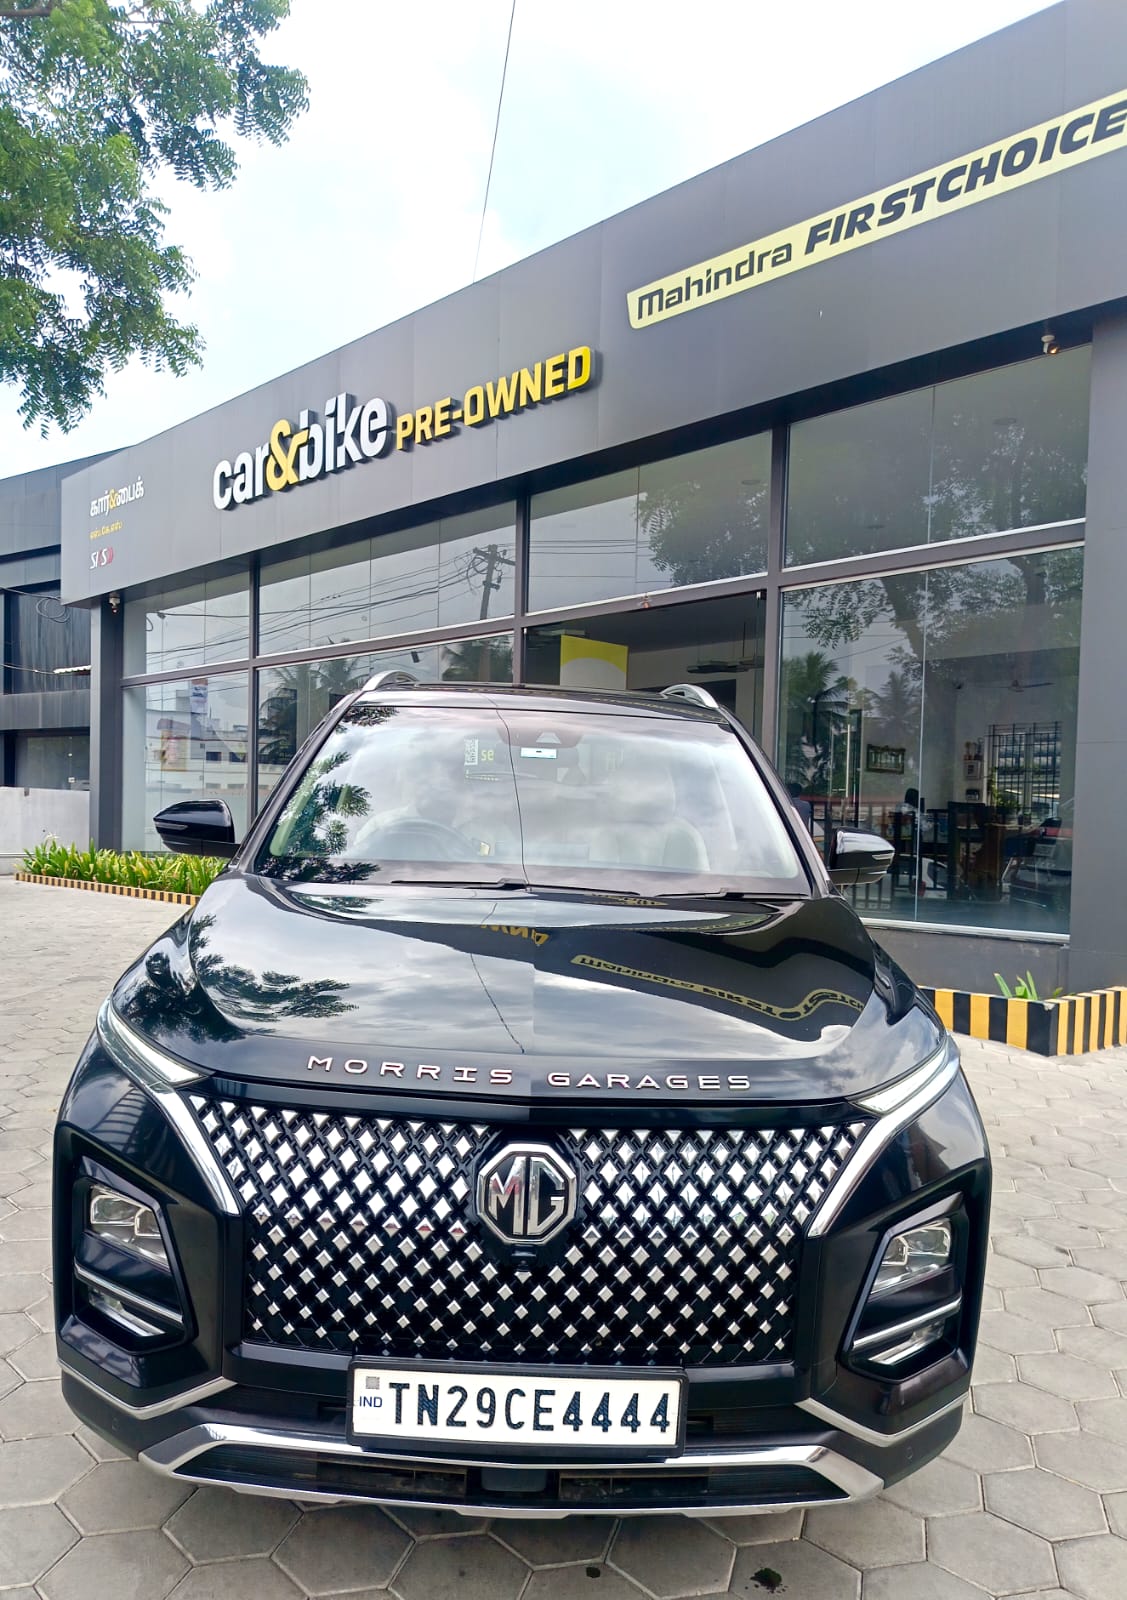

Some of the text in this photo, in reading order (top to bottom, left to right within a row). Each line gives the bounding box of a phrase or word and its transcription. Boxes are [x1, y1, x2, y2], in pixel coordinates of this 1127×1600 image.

[637, 99, 1127, 320] Mahindra FIRSTCHOICE
[212, 345, 592, 510] car&bike PRE-OWNED
[307, 1055, 751, 1090] MORRIS GARAGES
[488, 1156, 565, 1236] MG
[359, 1396, 383, 1408] IND
[389, 1382, 670, 1433] TN29CE4444
